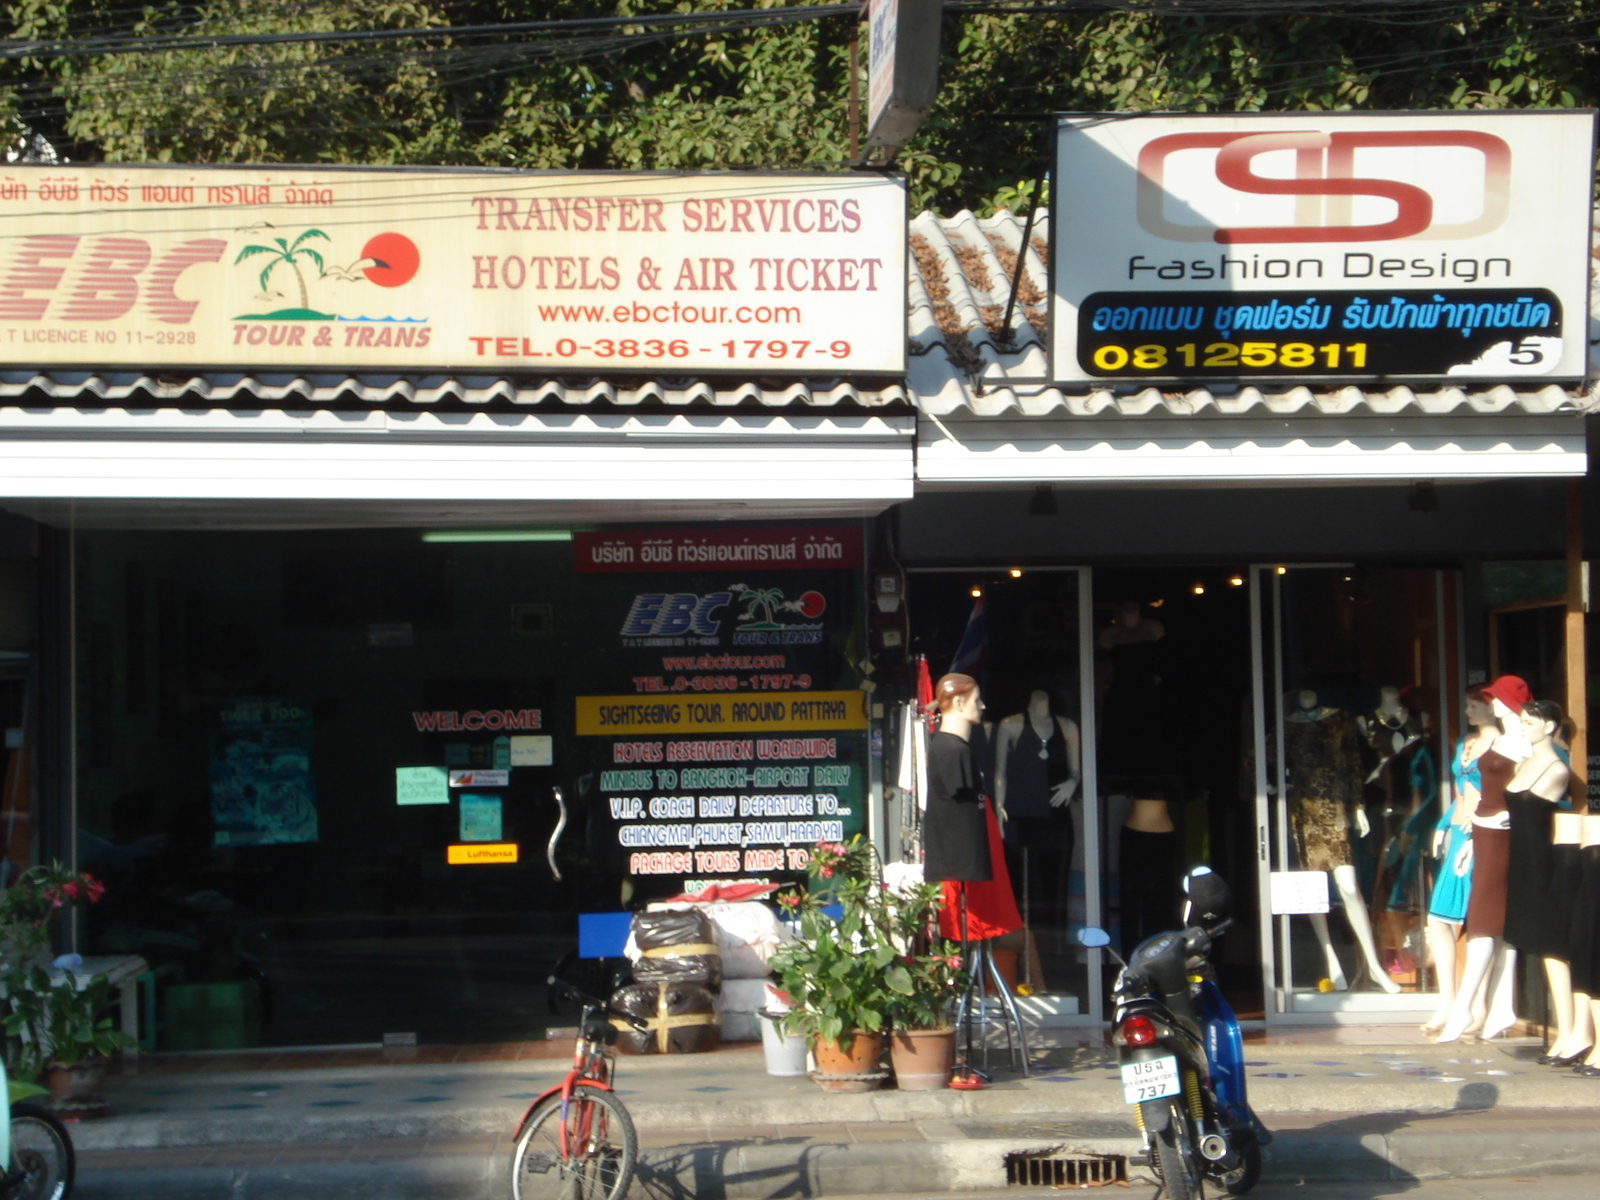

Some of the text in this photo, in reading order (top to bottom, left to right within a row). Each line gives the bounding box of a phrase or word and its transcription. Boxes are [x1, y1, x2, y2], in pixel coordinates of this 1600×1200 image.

[89, 178, 129, 203] ทัวร์
[141, 177, 195, 203] แอนด์
[207, 177, 271, 204] ทรานส์
[284, 180, 334, 206] จำกัด
[471, 197, 862, 234] TRANSFER SERVICES
[0, 235, 228, 324] EBC
[472, 255, 883, 292] HOTELS & AIR TICKET
[1128, 252, 1511, 283] Fashion Design
[538, 301, 801, 324] www.ebctour.com
[1092, 306, 1203, 332] ออกแบบ
[1213, 298, 1332, 340] ชุดฟอร์ม
[23, 329, 88, 343] LICENCE
[95, 330, 117, 343] NO
[126, 331, 197, 345] 11-2928
[232, 324, 432, 348] TOUR & TRANS
[1093, 340, 1544, 370] 08125811 5
[620, 591, 733, 636] EBC
[732, 632, 766, 645] TOUR
[781, 631, 823, 644] TRANS
[662, 653, 785, 671] www.ebctour.com
[412, 709, 542, 732] WELCOME
[599, 704, 681, 726] SIGHTSEEING
[732, 702, 785, 722] AROUND
[791, 700, 847, 721] PATTAYA
[613, 738, 836, 763] HOTELS RESERVATION WORLDWIDE
[600, 769, 653, 791] MINIBUS
[656, 768, 678, 789] TO
[814, 765, 850, 787] DAILY
[610, 797, 647, 819] V.I.P.
[649, 796, 695, 818] COACH
[699, 795, 736, 817] DAILY
[739, 794, 813, 816] DEPARTURE
[467, 850, 513, 859] Lufthansa
[630, 848, 808, 875] PACKAGE TOURS MADE TO
[1137, 1083, 1166, 1100] 737
